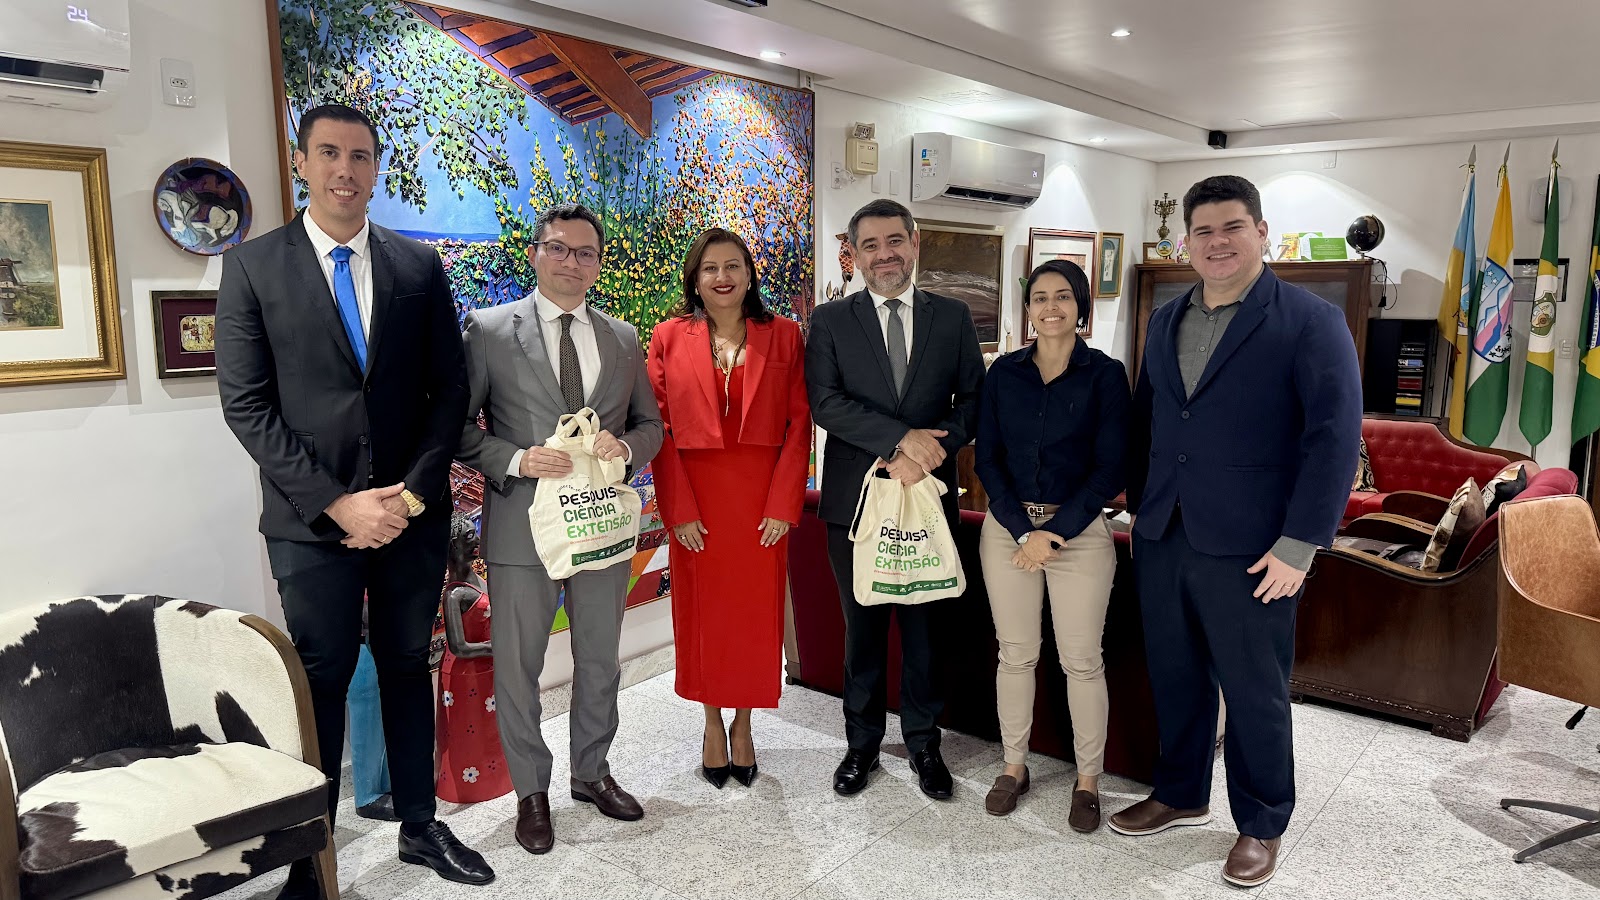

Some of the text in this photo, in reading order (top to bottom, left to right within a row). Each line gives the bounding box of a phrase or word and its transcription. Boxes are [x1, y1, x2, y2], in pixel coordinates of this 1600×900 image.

[67, 5, 88, 22] 24
[559, 486, 617, 507] PESQUIS
[563, 503, 616, 523] CIÊNCIA
[567, 512, 632, 538] EXTENSÃO
